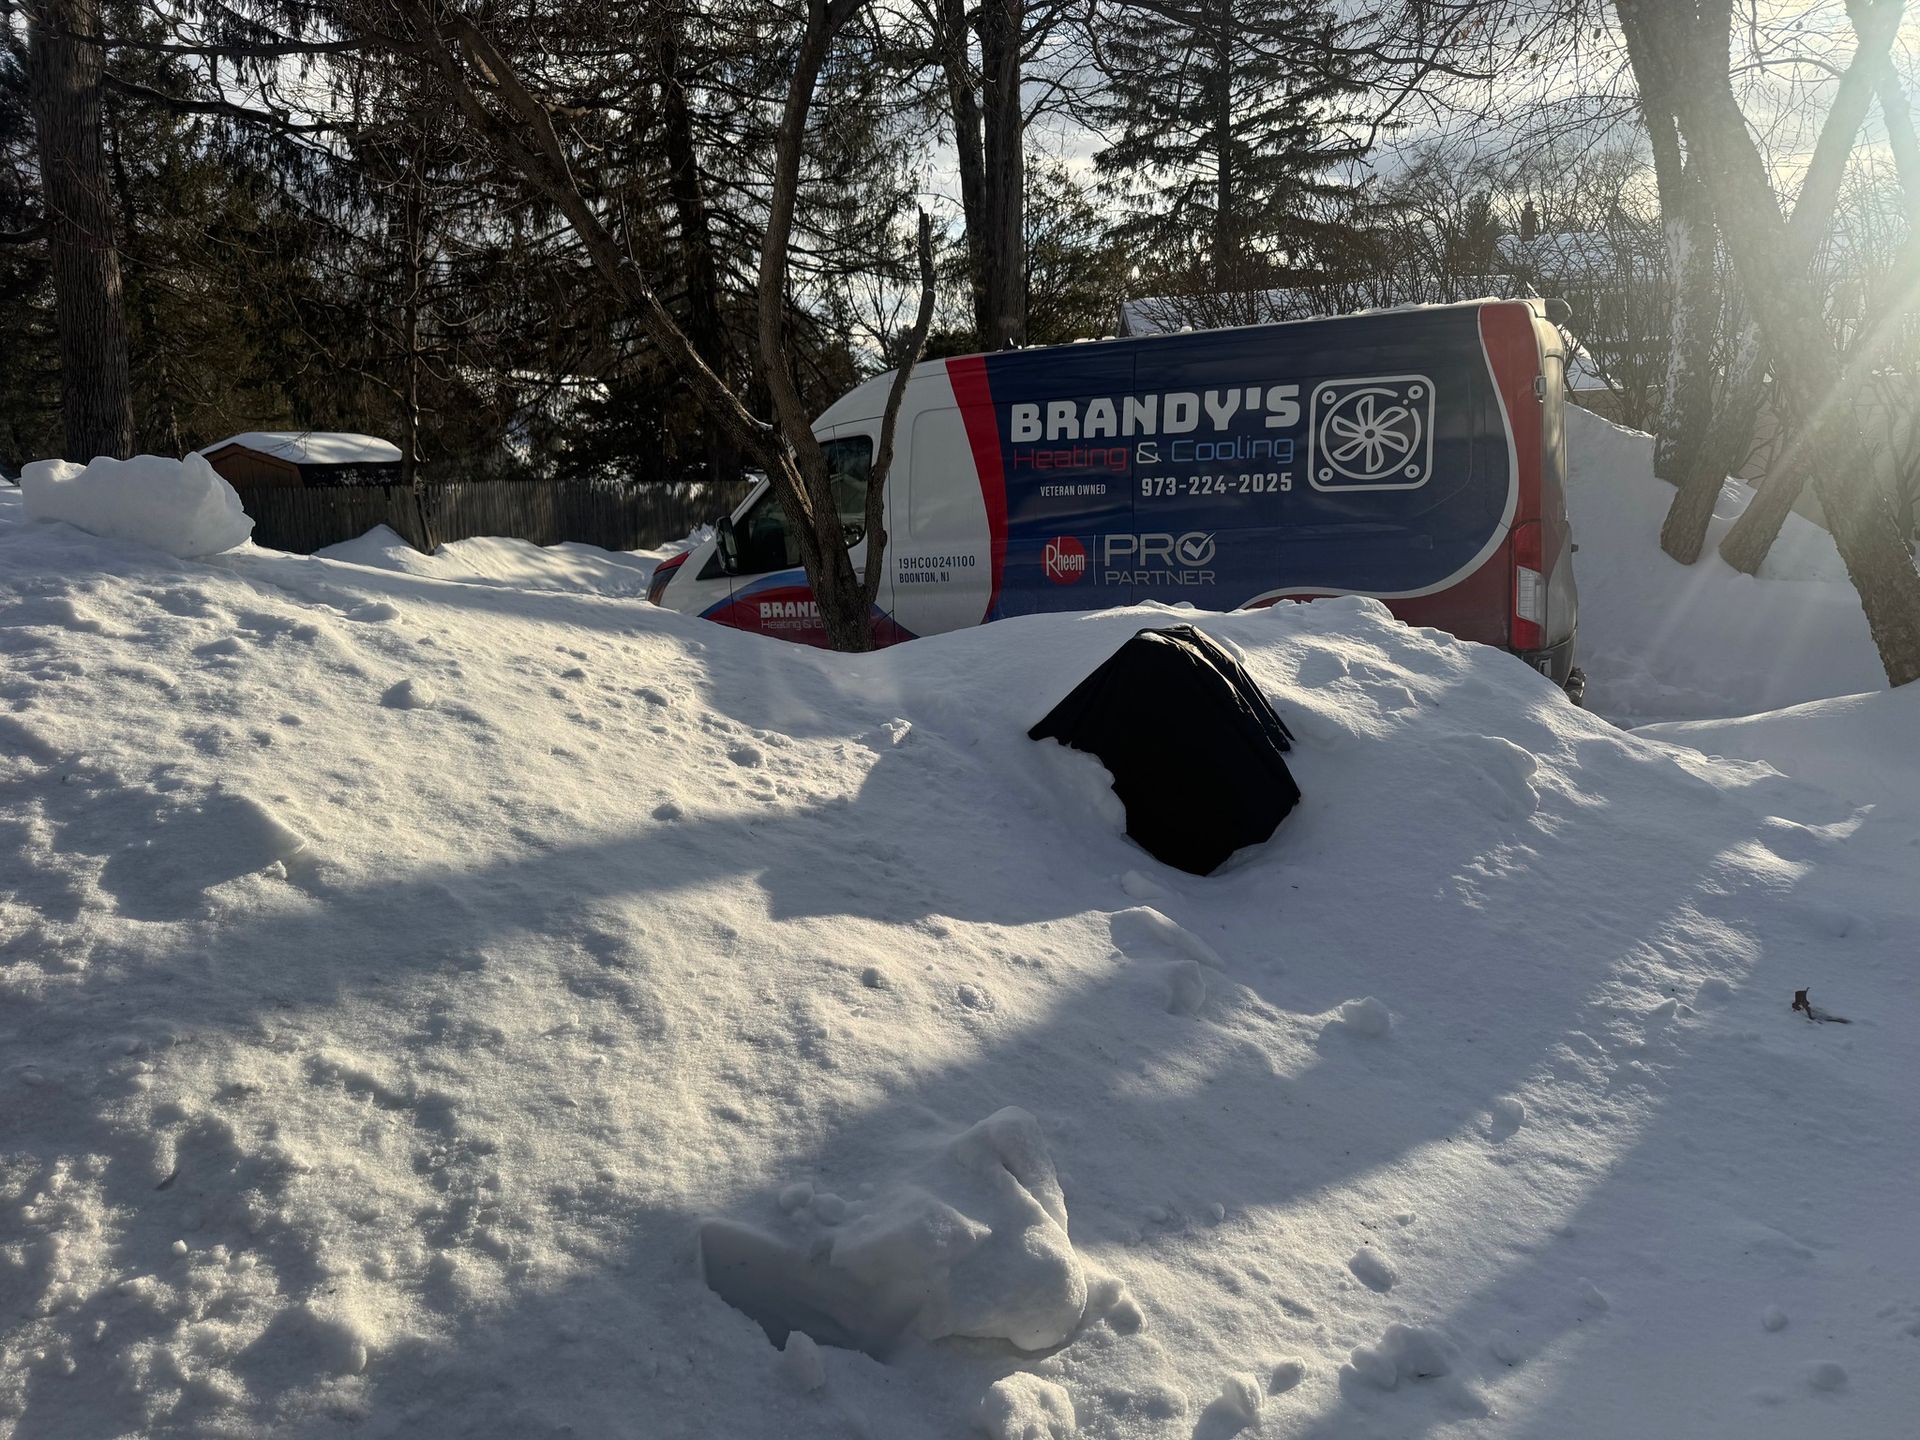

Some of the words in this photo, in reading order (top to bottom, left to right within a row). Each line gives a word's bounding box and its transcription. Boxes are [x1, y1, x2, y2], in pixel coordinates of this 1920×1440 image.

[1011, 384, 1301, 442] BRANDY'S
[1014, 445, 1127, 471] Heating
[1136, 442, 1162, 464] &
[1171, 436, 1294, 464] Cooling
[1040, 485, 1075, 497] VETERAN
[1077, 484, 1106, 496] OWNED
[1141, 472, 1293, 497] 973-224-2025
[1045, 536, 1085, 578] Rheem
[1104, 532, 1216, 567] PRO
[898, 555, 975, 569] 19HC00241100
[899, 572, 938, 583] BOONTON,
[940, 571, 950, 583] NJ
[1105, 569, 1216, 585] PARTNER
[760, 601, 820, 618] BRAND
[761, 620, 801, 631] Heating
